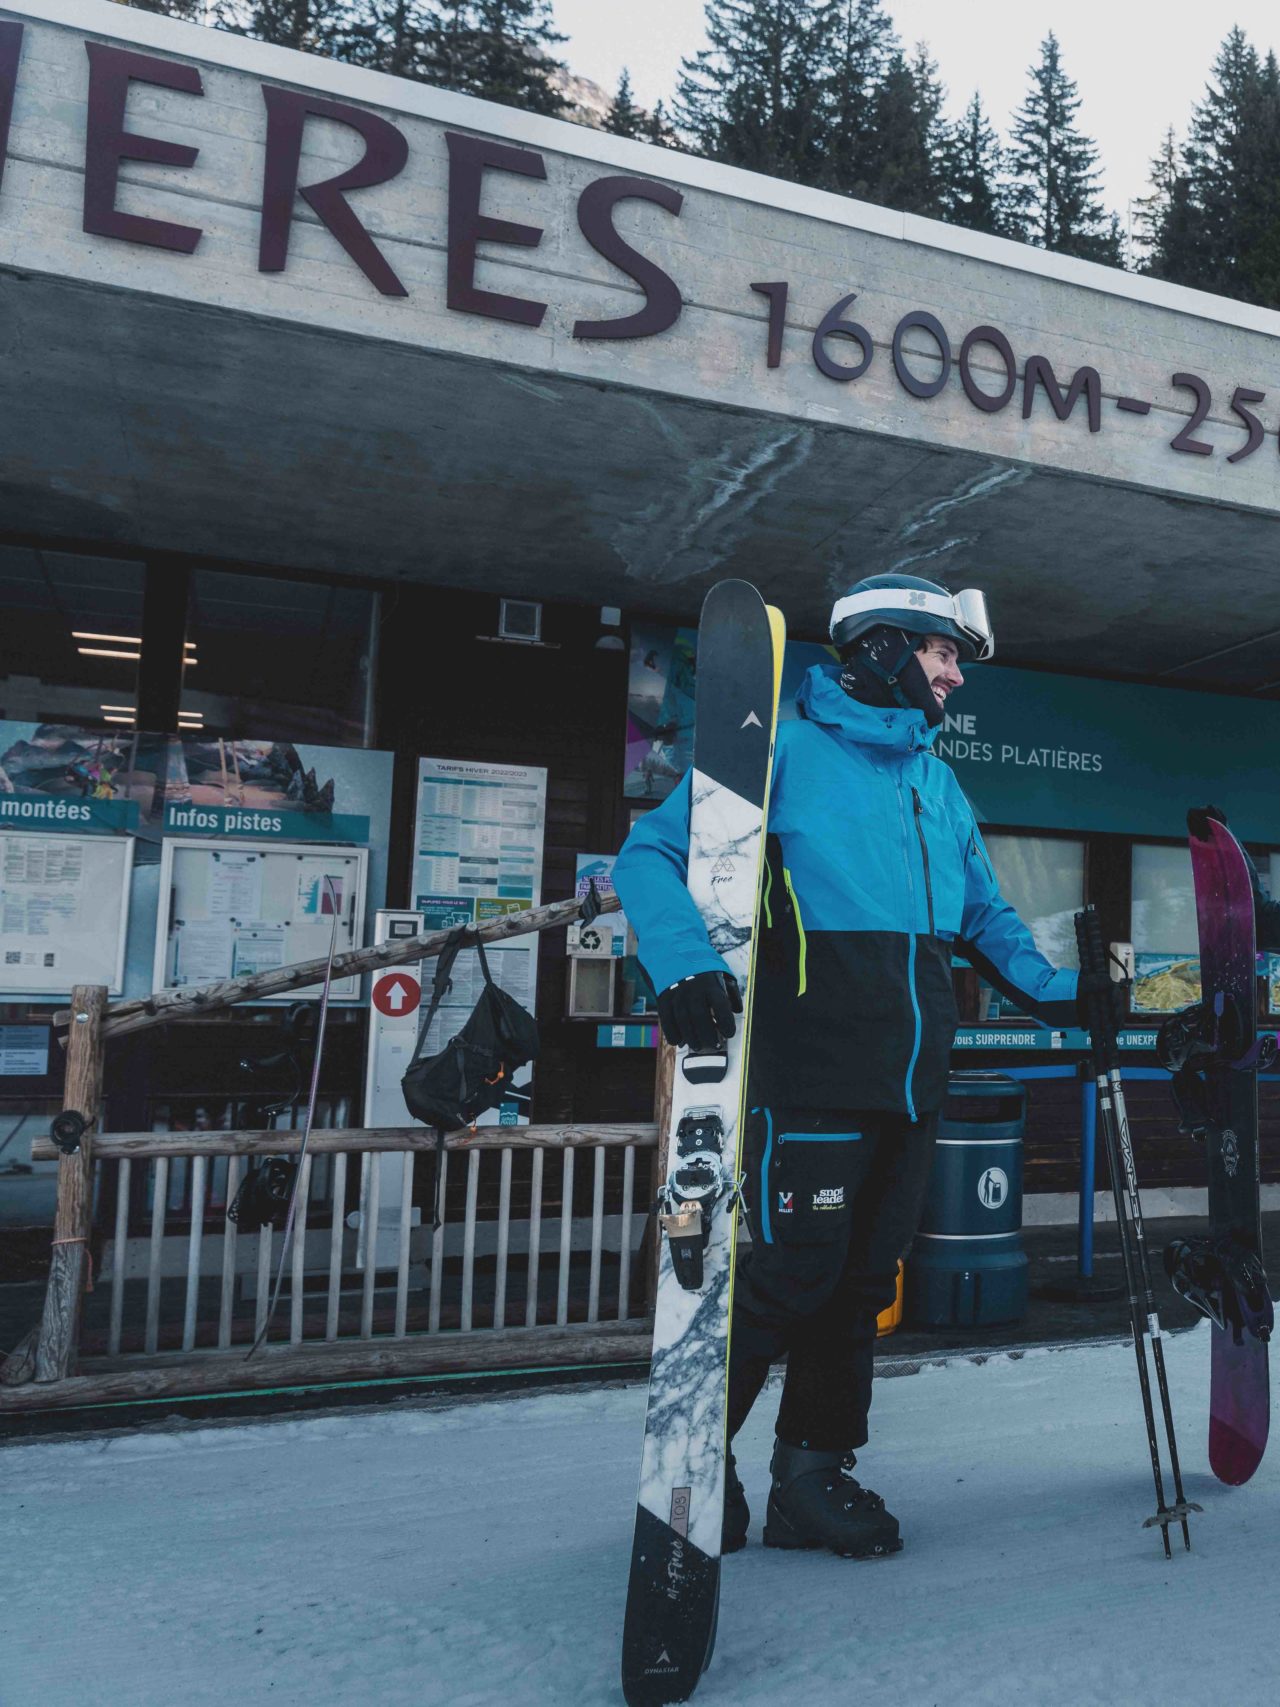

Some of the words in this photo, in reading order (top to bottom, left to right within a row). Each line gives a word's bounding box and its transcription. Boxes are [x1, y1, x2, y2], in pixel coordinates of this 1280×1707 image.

[436, 764, 465, 772] TARIFS
[1001, 745, 1103, 773] PLATIÈRES
[1, 800, 92, 821] montées
[168, 807, 219, 828] Infos
[224, 811, 282, 833] pistes
[975, 1034, 1036, 1046] SURPRENDRE
